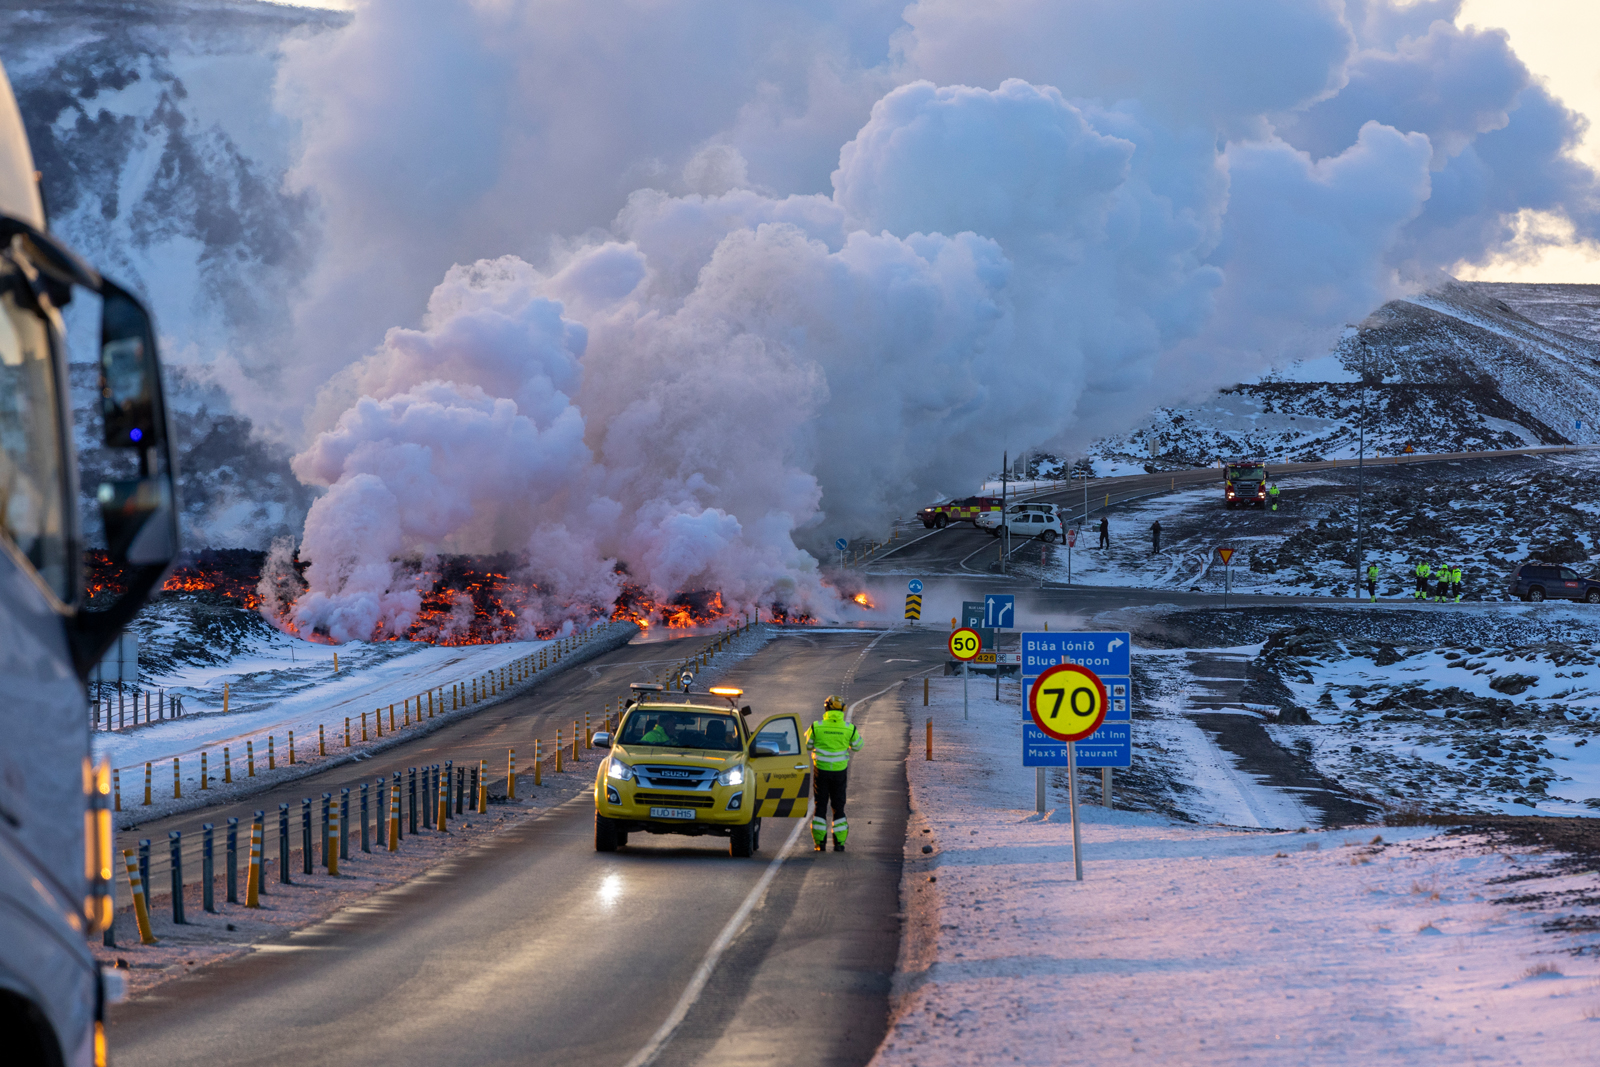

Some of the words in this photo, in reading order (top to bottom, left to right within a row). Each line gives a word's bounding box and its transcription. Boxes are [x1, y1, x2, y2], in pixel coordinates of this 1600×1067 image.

[954, 638, 976, 651] 50
[1028, 640, 1056, 651] Bláa
[1062, 640, 1095, 651] lónið
[1028, 656, 1056, 666] Blue
[1070, 658, 1110, 666] agoon
[1043, 686, 1096, 719] 70
